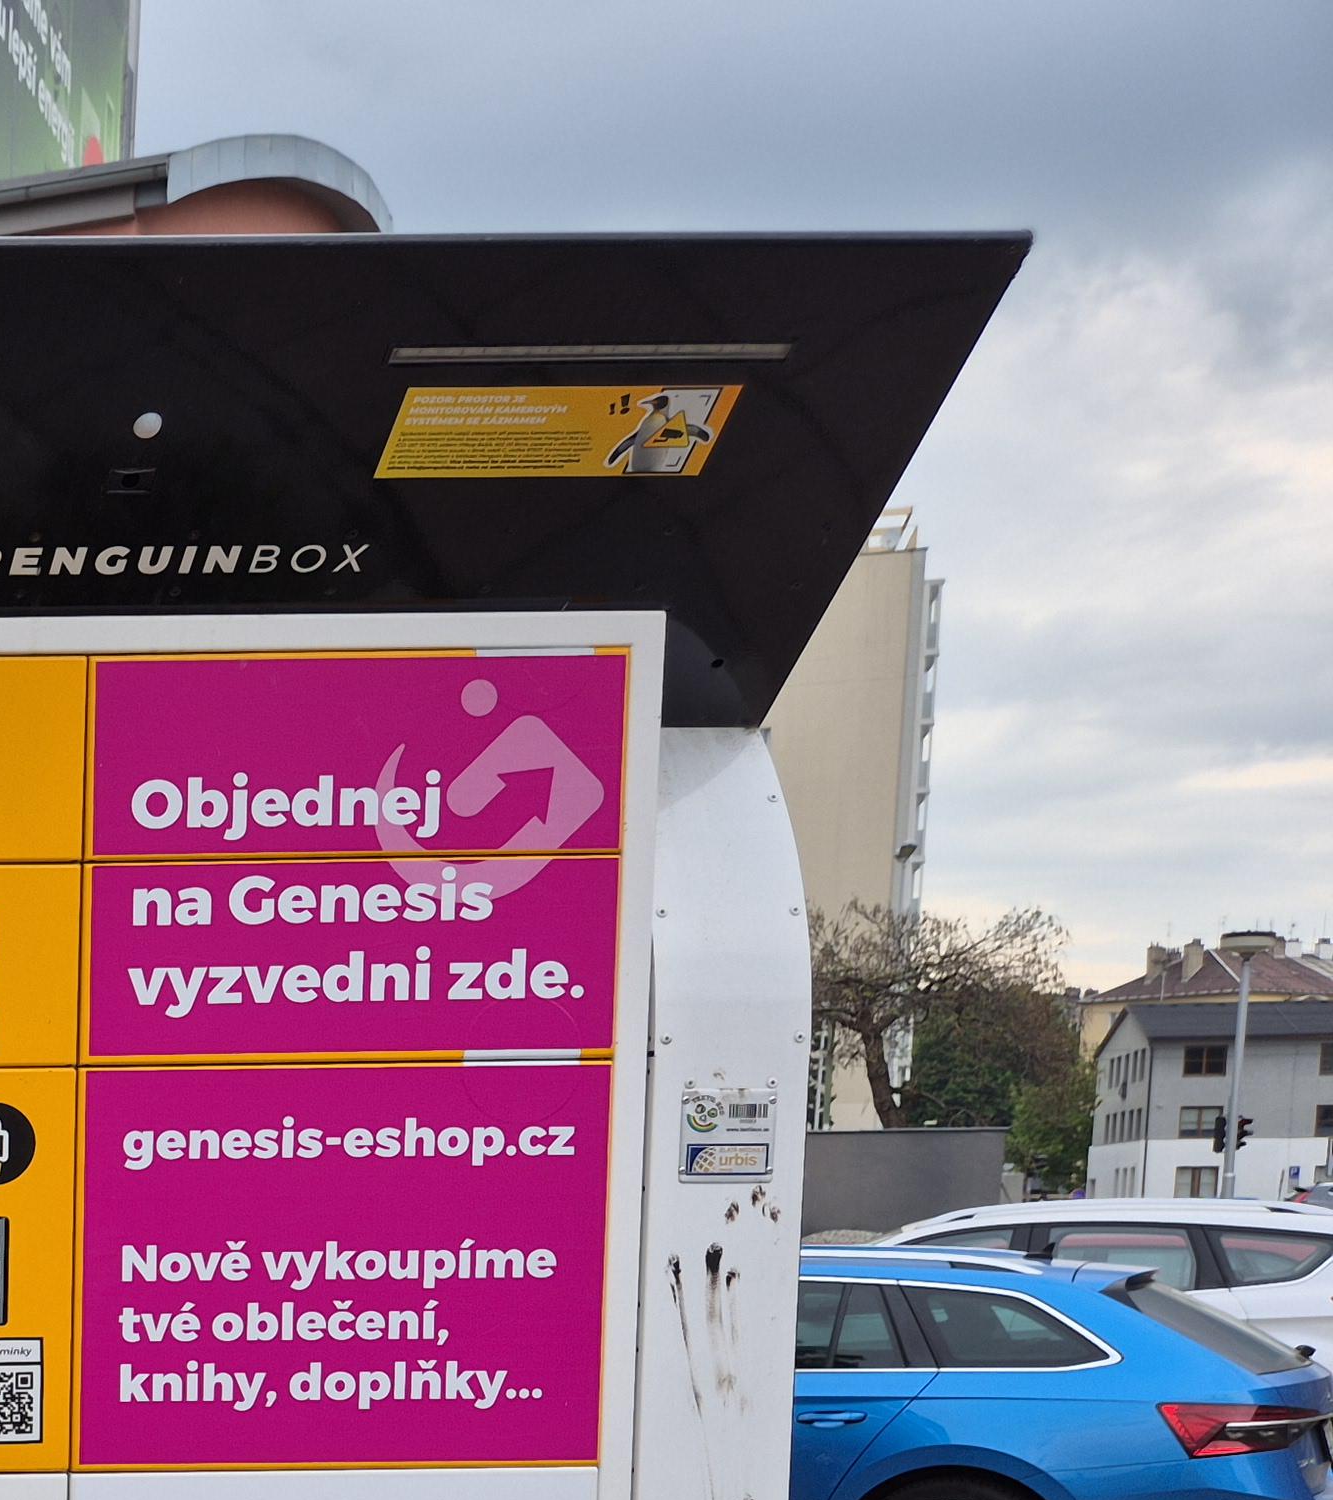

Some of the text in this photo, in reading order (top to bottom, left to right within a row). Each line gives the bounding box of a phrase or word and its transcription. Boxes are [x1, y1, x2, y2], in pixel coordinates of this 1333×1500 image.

[130, 769, 442, 841] Objednej
[132, 867, 494, 927] na Genesis
[127, 945, 585, 1019] vyzvedni zde.
[122, 1115, 576, 1171] genesis-eshop.cz
[718, 1153, 758, 1167] urbis
[121, 1238, 557, 1291] Nově vykoupíme
[118, 1299, 450, 1347] tvé oblečení,
[119, 1359, 543, 1412] knihy, doplňky...
